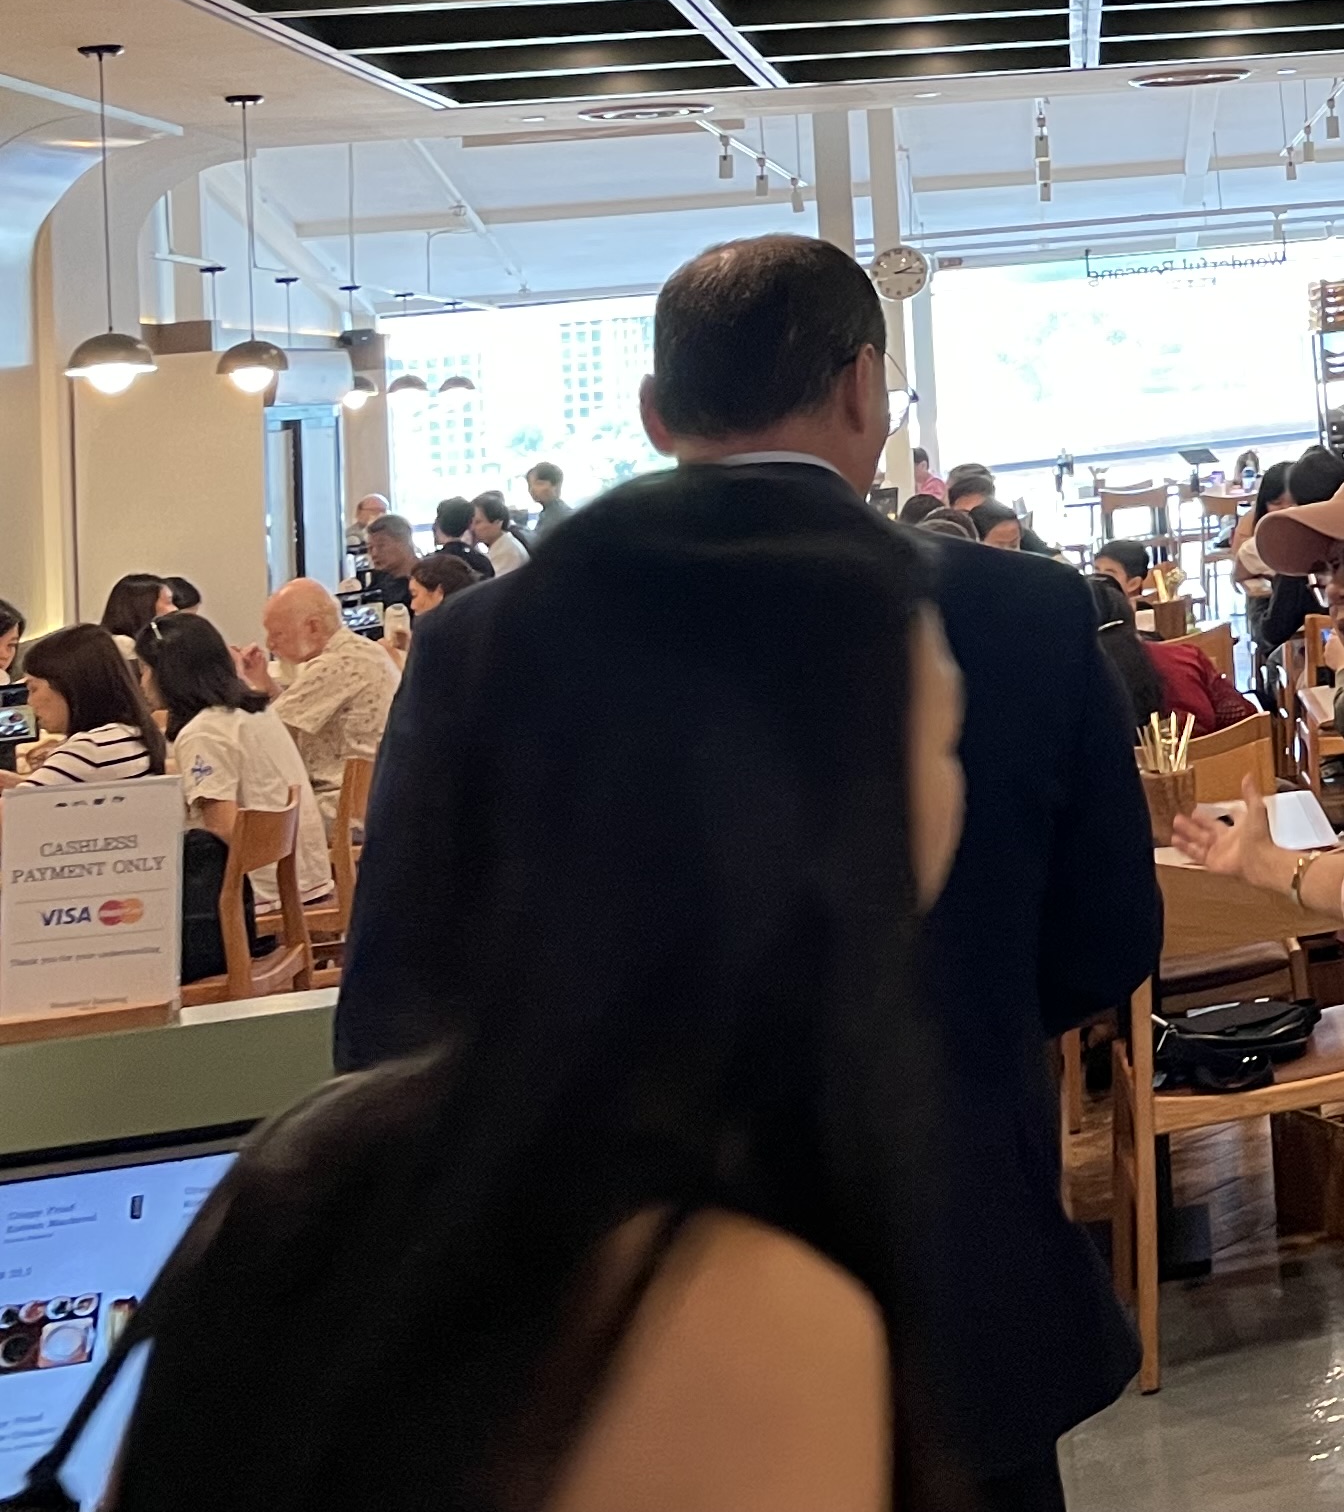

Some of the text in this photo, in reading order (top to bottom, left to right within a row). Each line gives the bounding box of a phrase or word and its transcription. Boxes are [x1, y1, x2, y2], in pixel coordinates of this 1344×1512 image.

[39, 834, 139, 858] CASHLESS
[11, 856, 167, 884] PAYMENT ONLY
[40, 906, 92, 926] VISA
